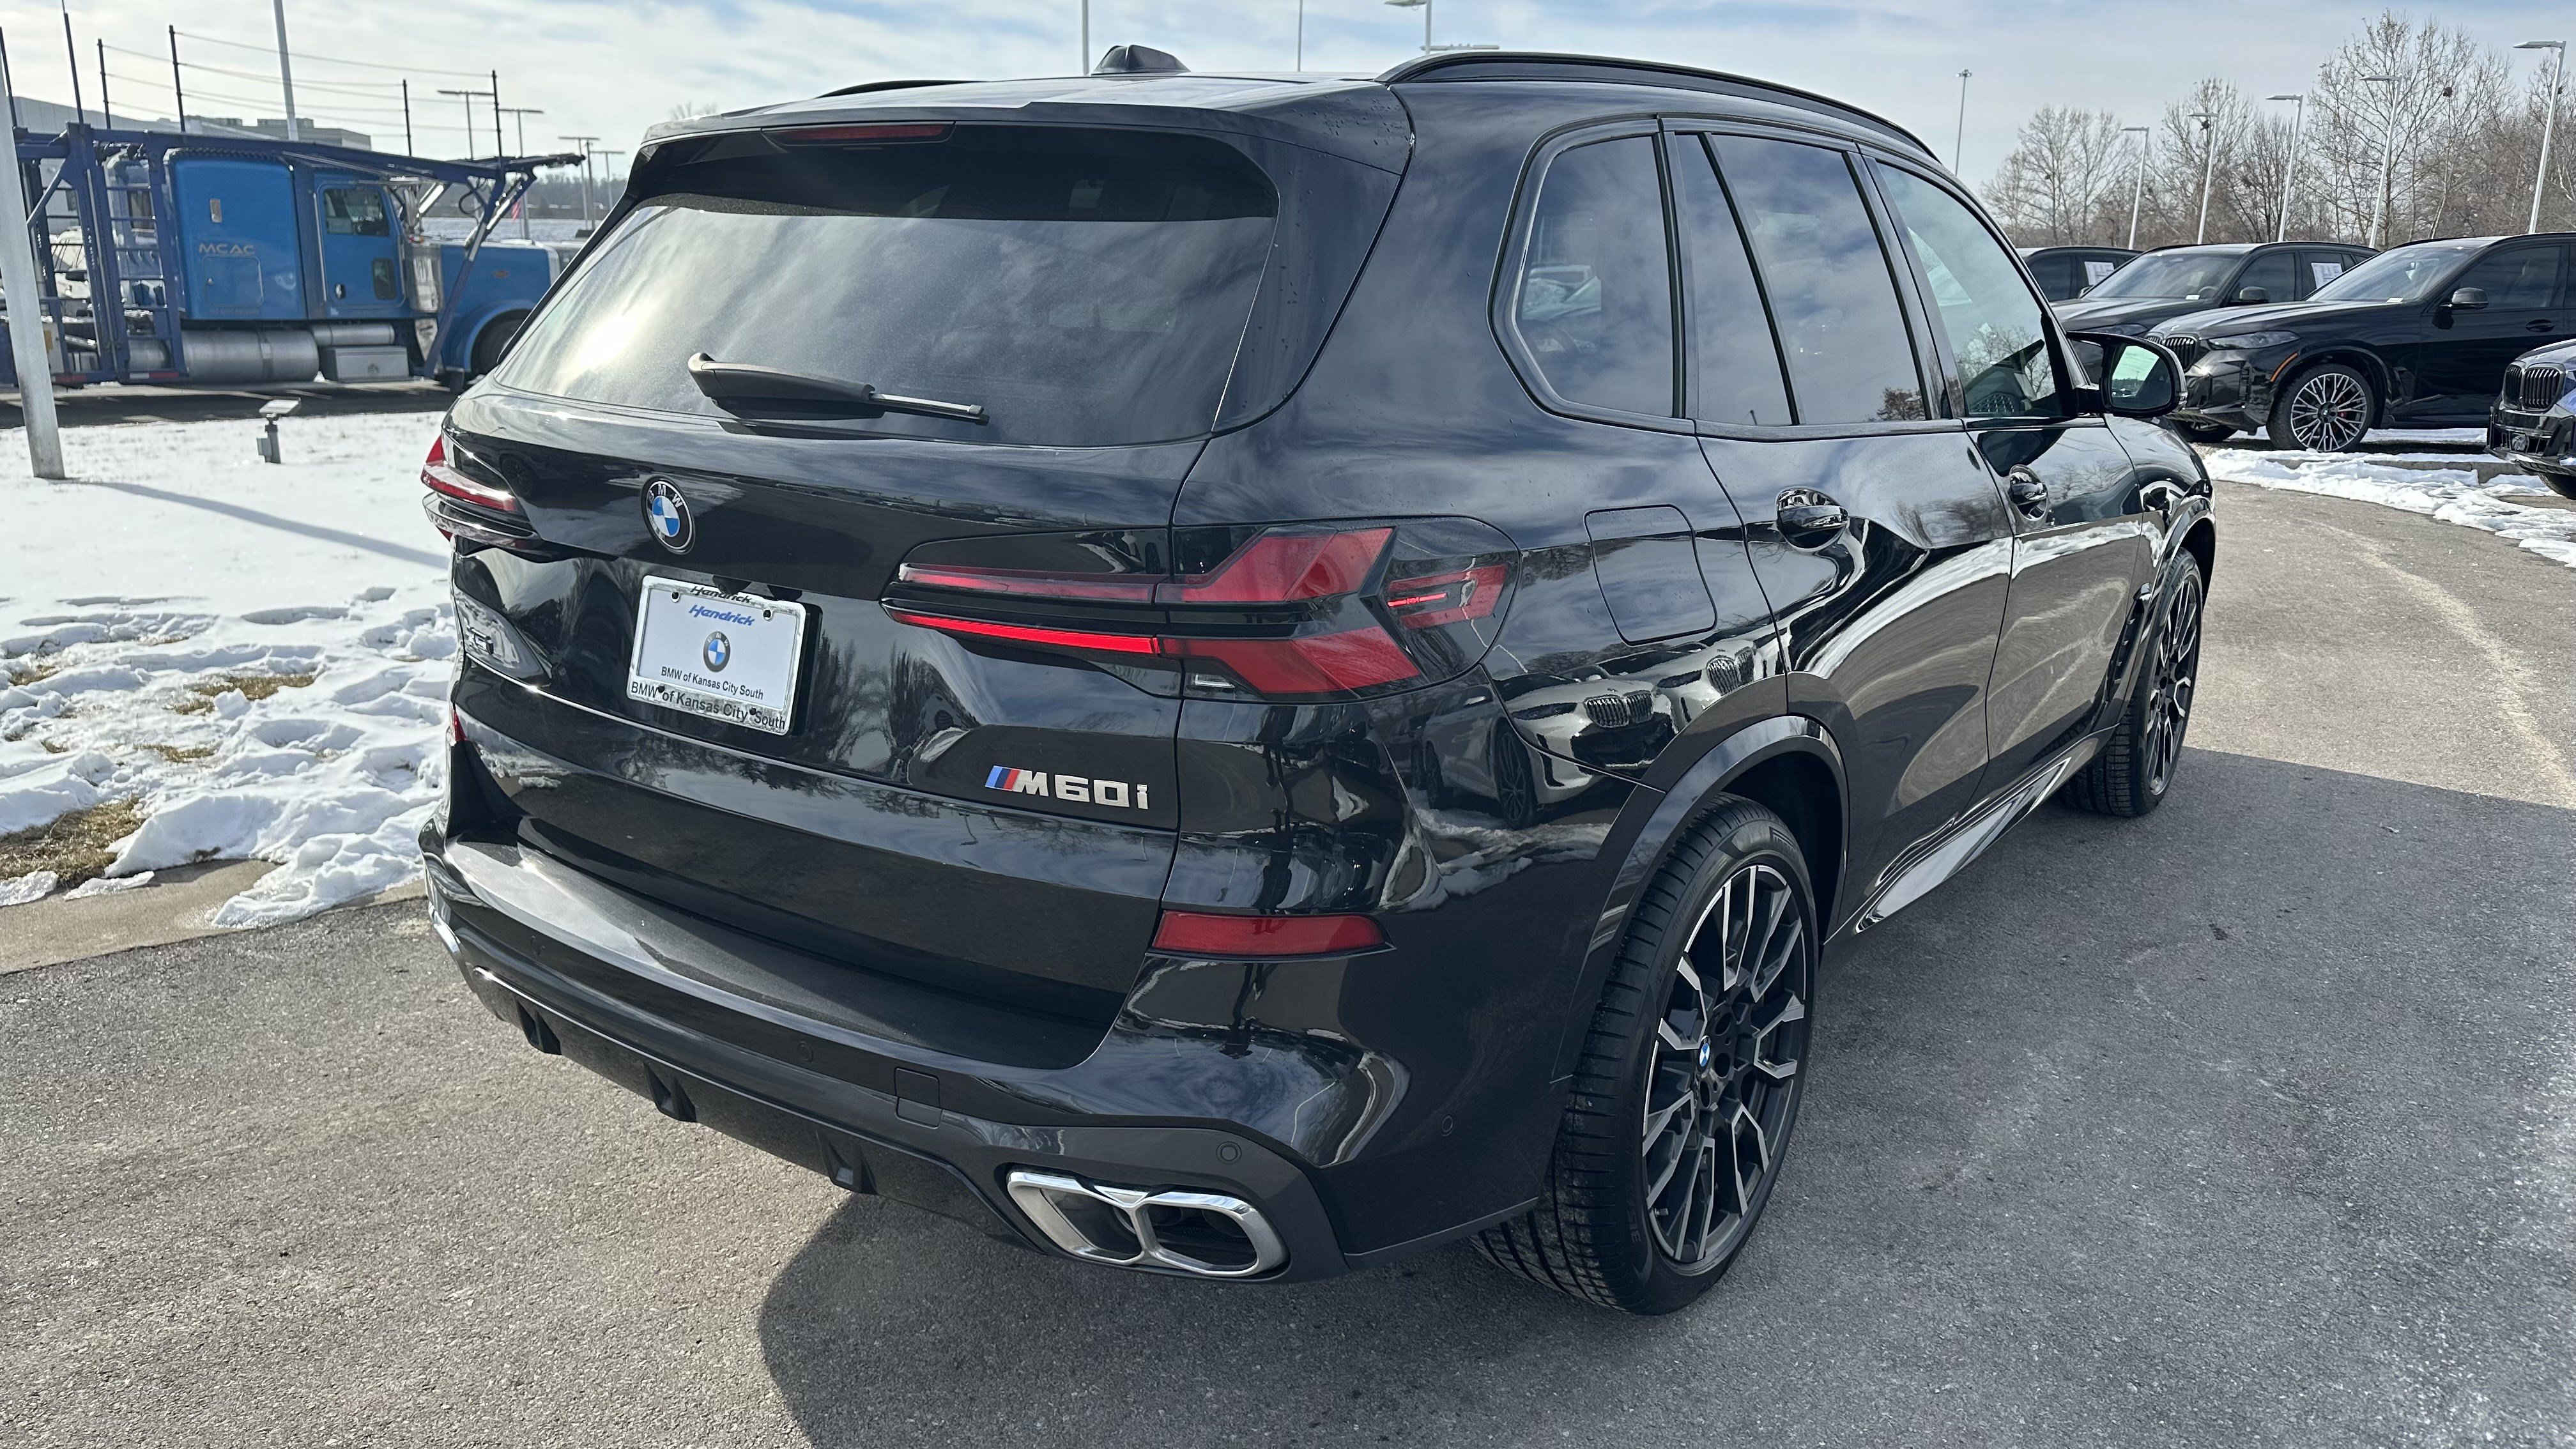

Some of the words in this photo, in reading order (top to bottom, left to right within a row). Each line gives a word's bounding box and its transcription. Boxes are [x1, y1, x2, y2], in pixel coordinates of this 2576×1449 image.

[199, 243, 256, 254] MCAC
[689, 604, 755, 625] Hendrick
[661, 666, 682, 680] BMW
[683, 674, 692, 682] of
[693, 673, 721, 689] Kansas
[723, 681, 739, 695] City
[740, 685, 763, 700] South
[631, 682, 658, 699] BMW
[662, 689, 675, 702] of
[677, 691, 719, 714] Kansas
[723, 703, 748, 723] City
[754, 709, 786, 730] South
[1011, 769, 1149, 809] M60i
